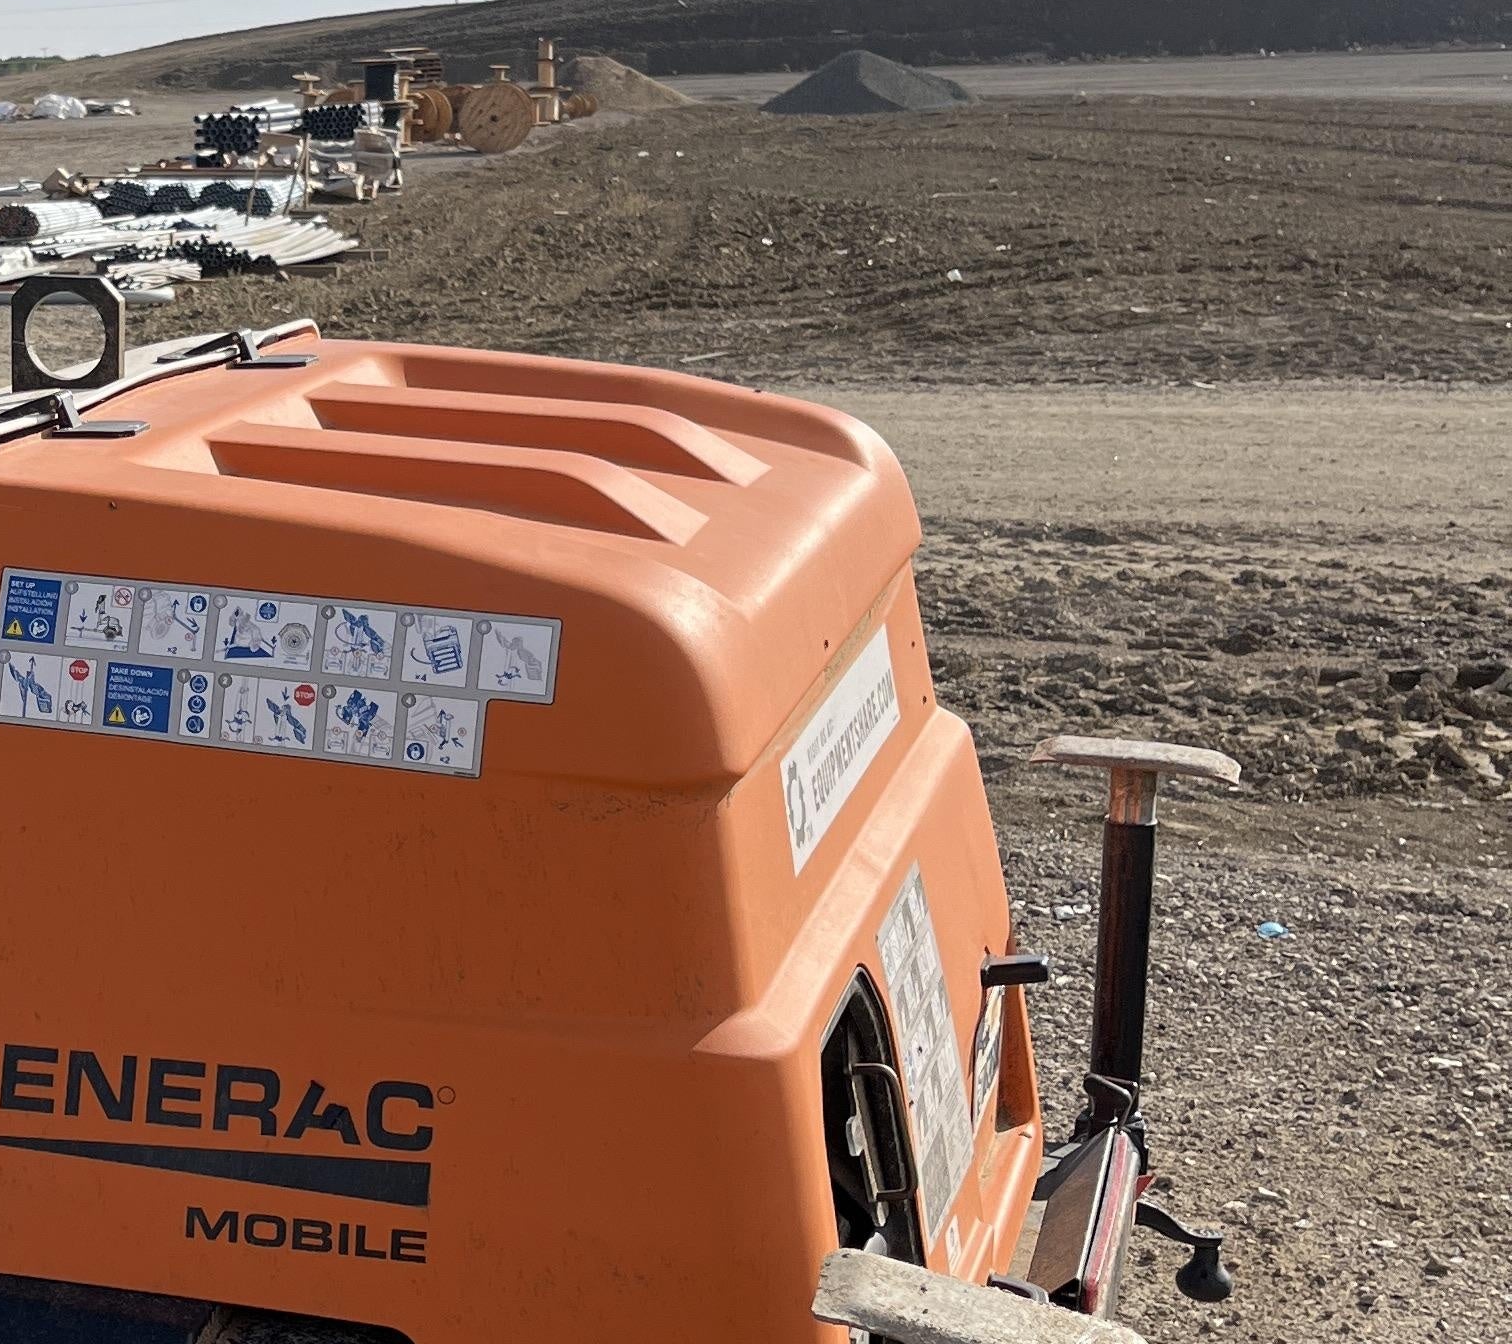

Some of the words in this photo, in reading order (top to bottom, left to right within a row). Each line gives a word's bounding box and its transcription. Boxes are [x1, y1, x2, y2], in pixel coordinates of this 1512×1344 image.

[70, 665, 89, 675] STOP
[110, 666, 129, 676] TAKE
[130, 668, 154, 678] DOWN
[295, 690, 316, 700] STOP
[811, 668, 895, 812] EQUIPMENTSHARE.COM
[185, 1205, 427, 1264] MOBILE
